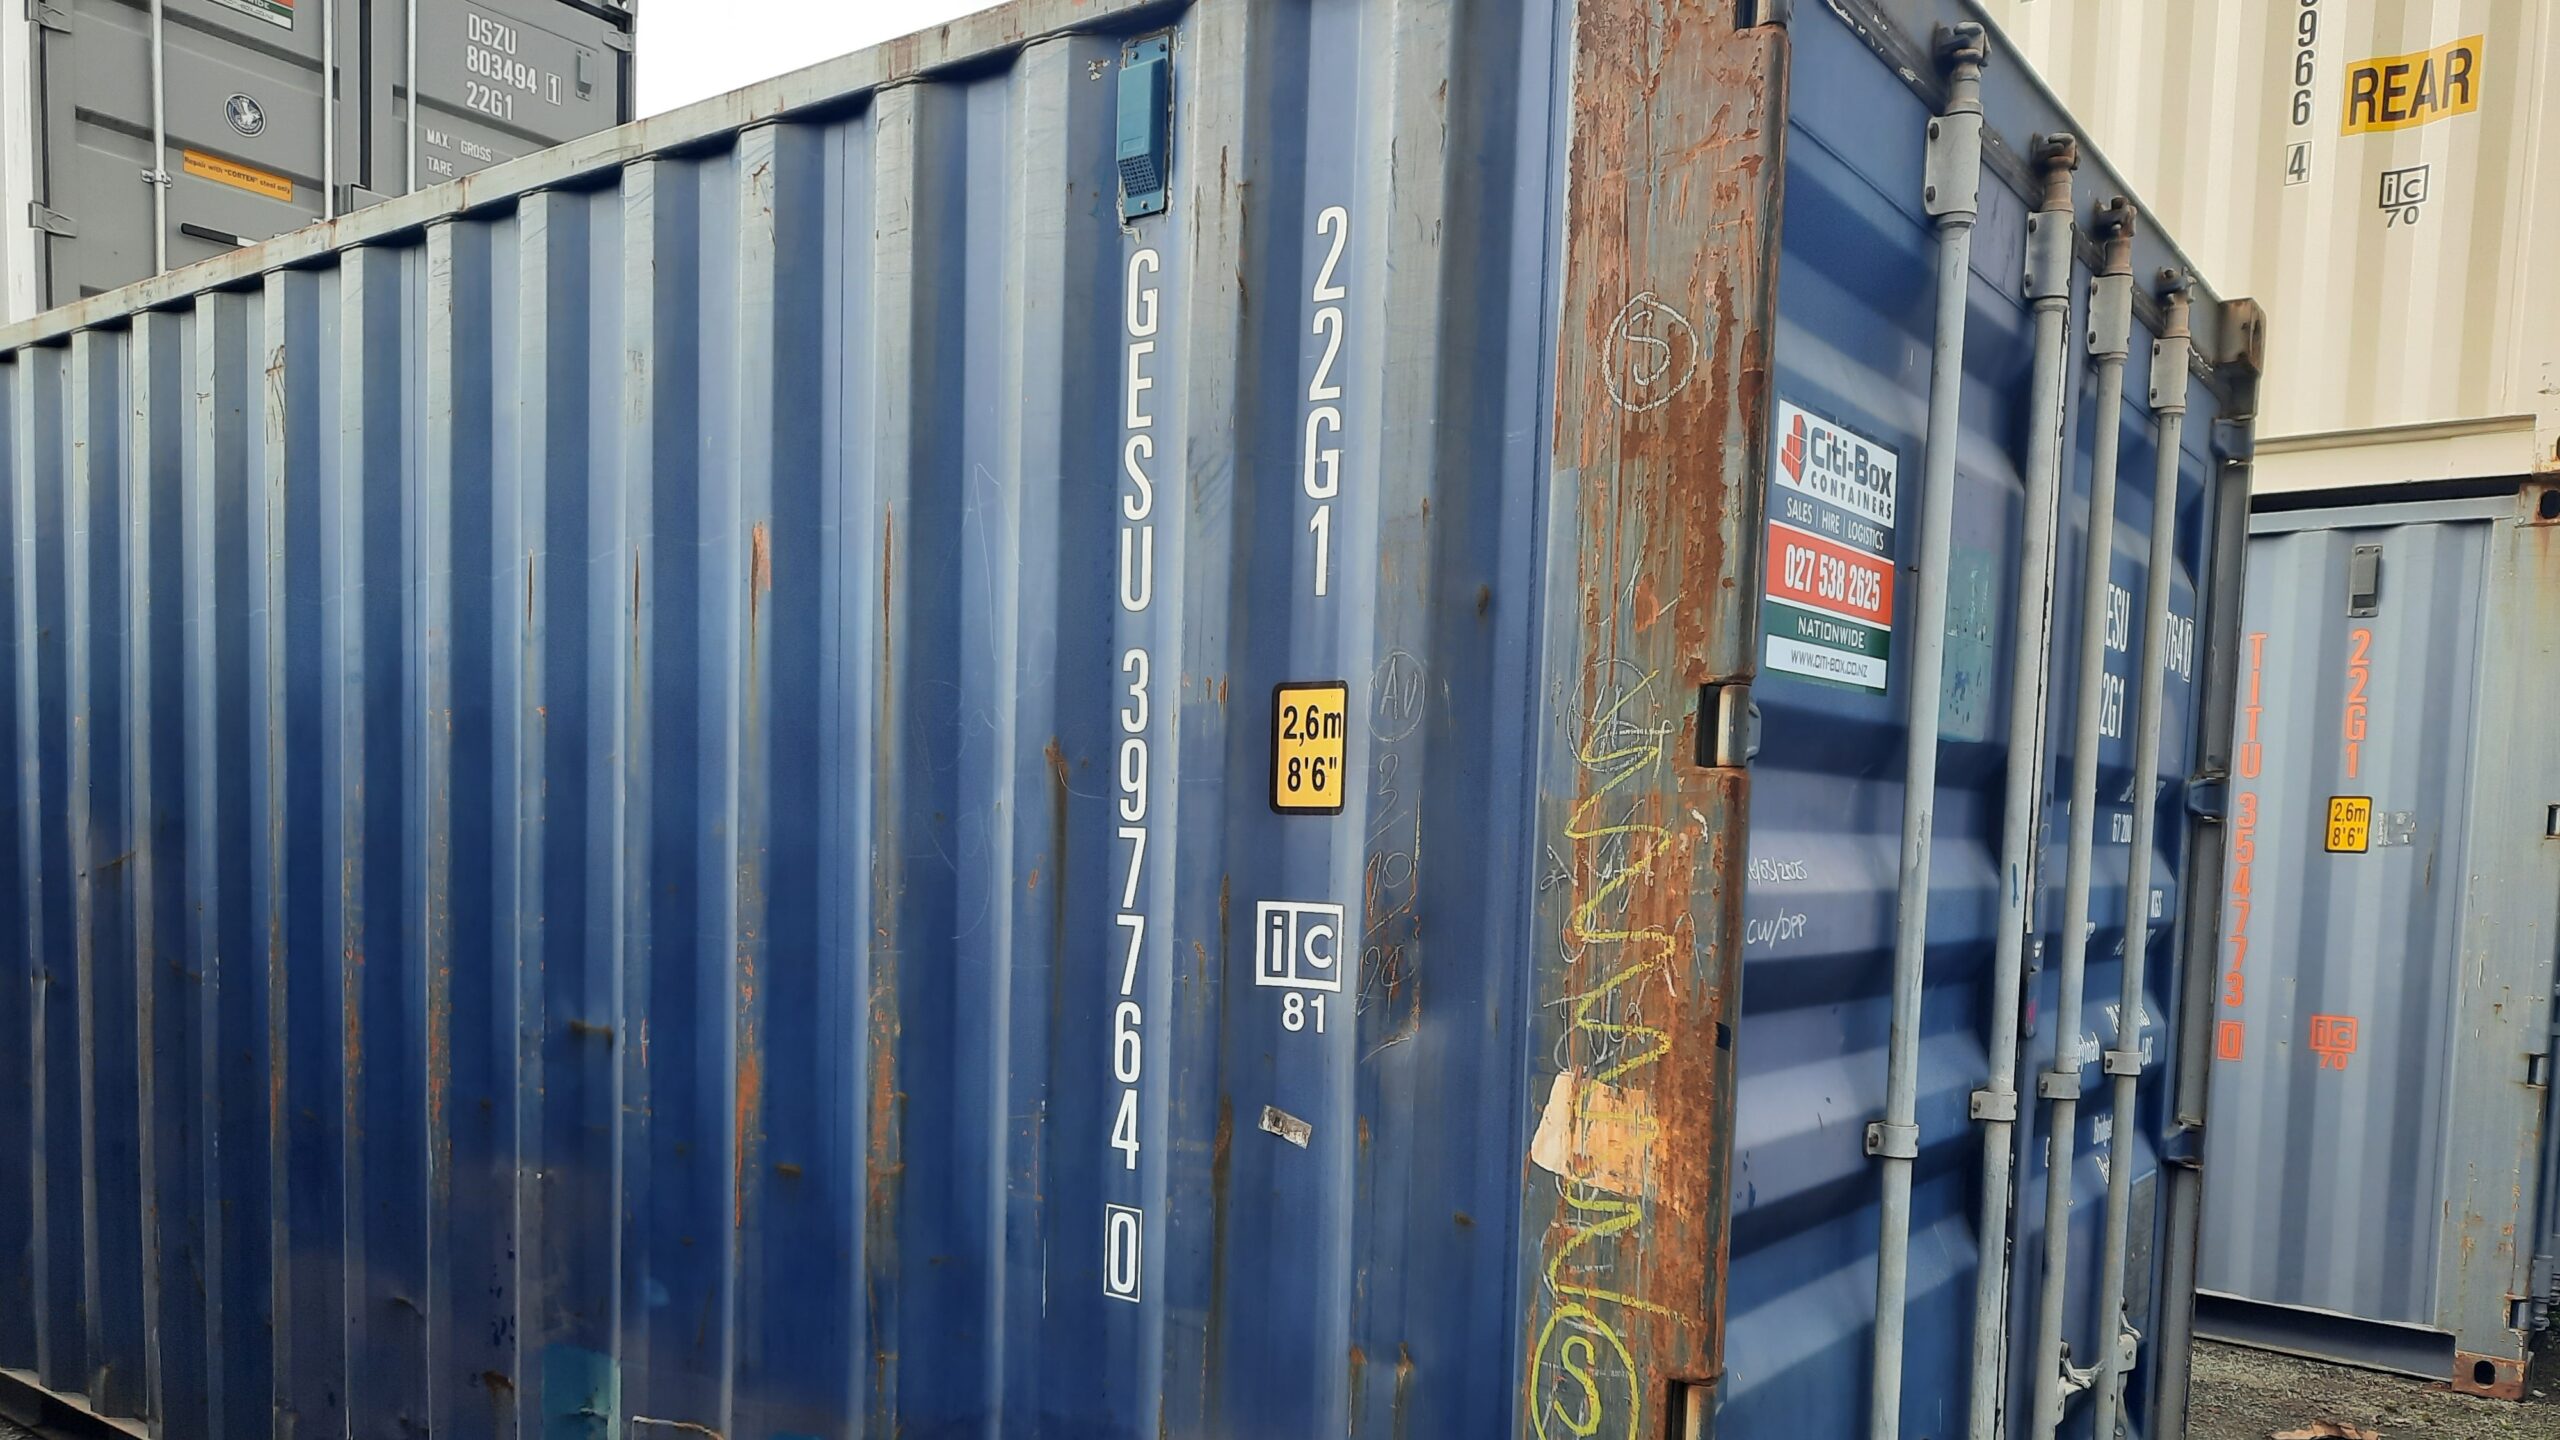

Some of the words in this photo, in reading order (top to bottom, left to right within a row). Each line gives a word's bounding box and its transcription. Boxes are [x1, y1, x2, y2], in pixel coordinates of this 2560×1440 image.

[468, 13, 517, 55] DSZU
[466, 45, 538, 95] 803494
[548, 73, 561, 105] 1
[2291, 0, 2318, 126] 966
[466, 81, 513, 121] 22G1
[2349, 47, 2473, 126] REAR
[426, 128, 452, 150] MAX.
[460, 139, 492, 162] GROSS
[426, 155, 453, 177] TARE
[2286, 143, 2309, 184] 4
[184, 156, 206, 168] Repair
[208, 163, 223, 174] with
[259, 179, 276, 190] steel
[277, 184, 290, 194] only
[2385, 205, 2420, 228] 70
[1303, 206, 1347, 596] 22G1
[1120, 248, 1160, 612] GESU
[1811, 470, 1892, 520] CONTAINERS
[1787, 496, 1813, 525] SALES
[1822, 509, 1840, 534] HIRE
[1847, 519, 1884, 551] LOGISTICS
[1785, 544, 1815, 593] 027
[1819, 554, 1845, 602] 538
[1848, 564, 1881, 612] 2625
[1798, 615, 1865, 649] NATIONWIDE
[2105, 583, 2130, 652] ESU
[2165, 612, 2184, 673] 764
[1283, 704, 1341, 747] 2,6m
[2100, 672, 2125, 739] 2G1
[2240, 633, 2267, 778] TITU
[2345, 628, 2371, 778] 22G1
[1287, 756, 1337, 792] 8'6"
[2333, 826, 2363, 847] 8'6"
[2334, 802, 2366, 825] 2,6m
[1111, 648, 1149, 1169] 397764
[2224, 793, 2257, 1006] 354773
[1282, 991, 1325, 1034] 81
[2219, 1022, 2242, 1060] 0
[2318, 1051, 2348, 1071] 70
[1108, 1208, 1140, 1297] 0
